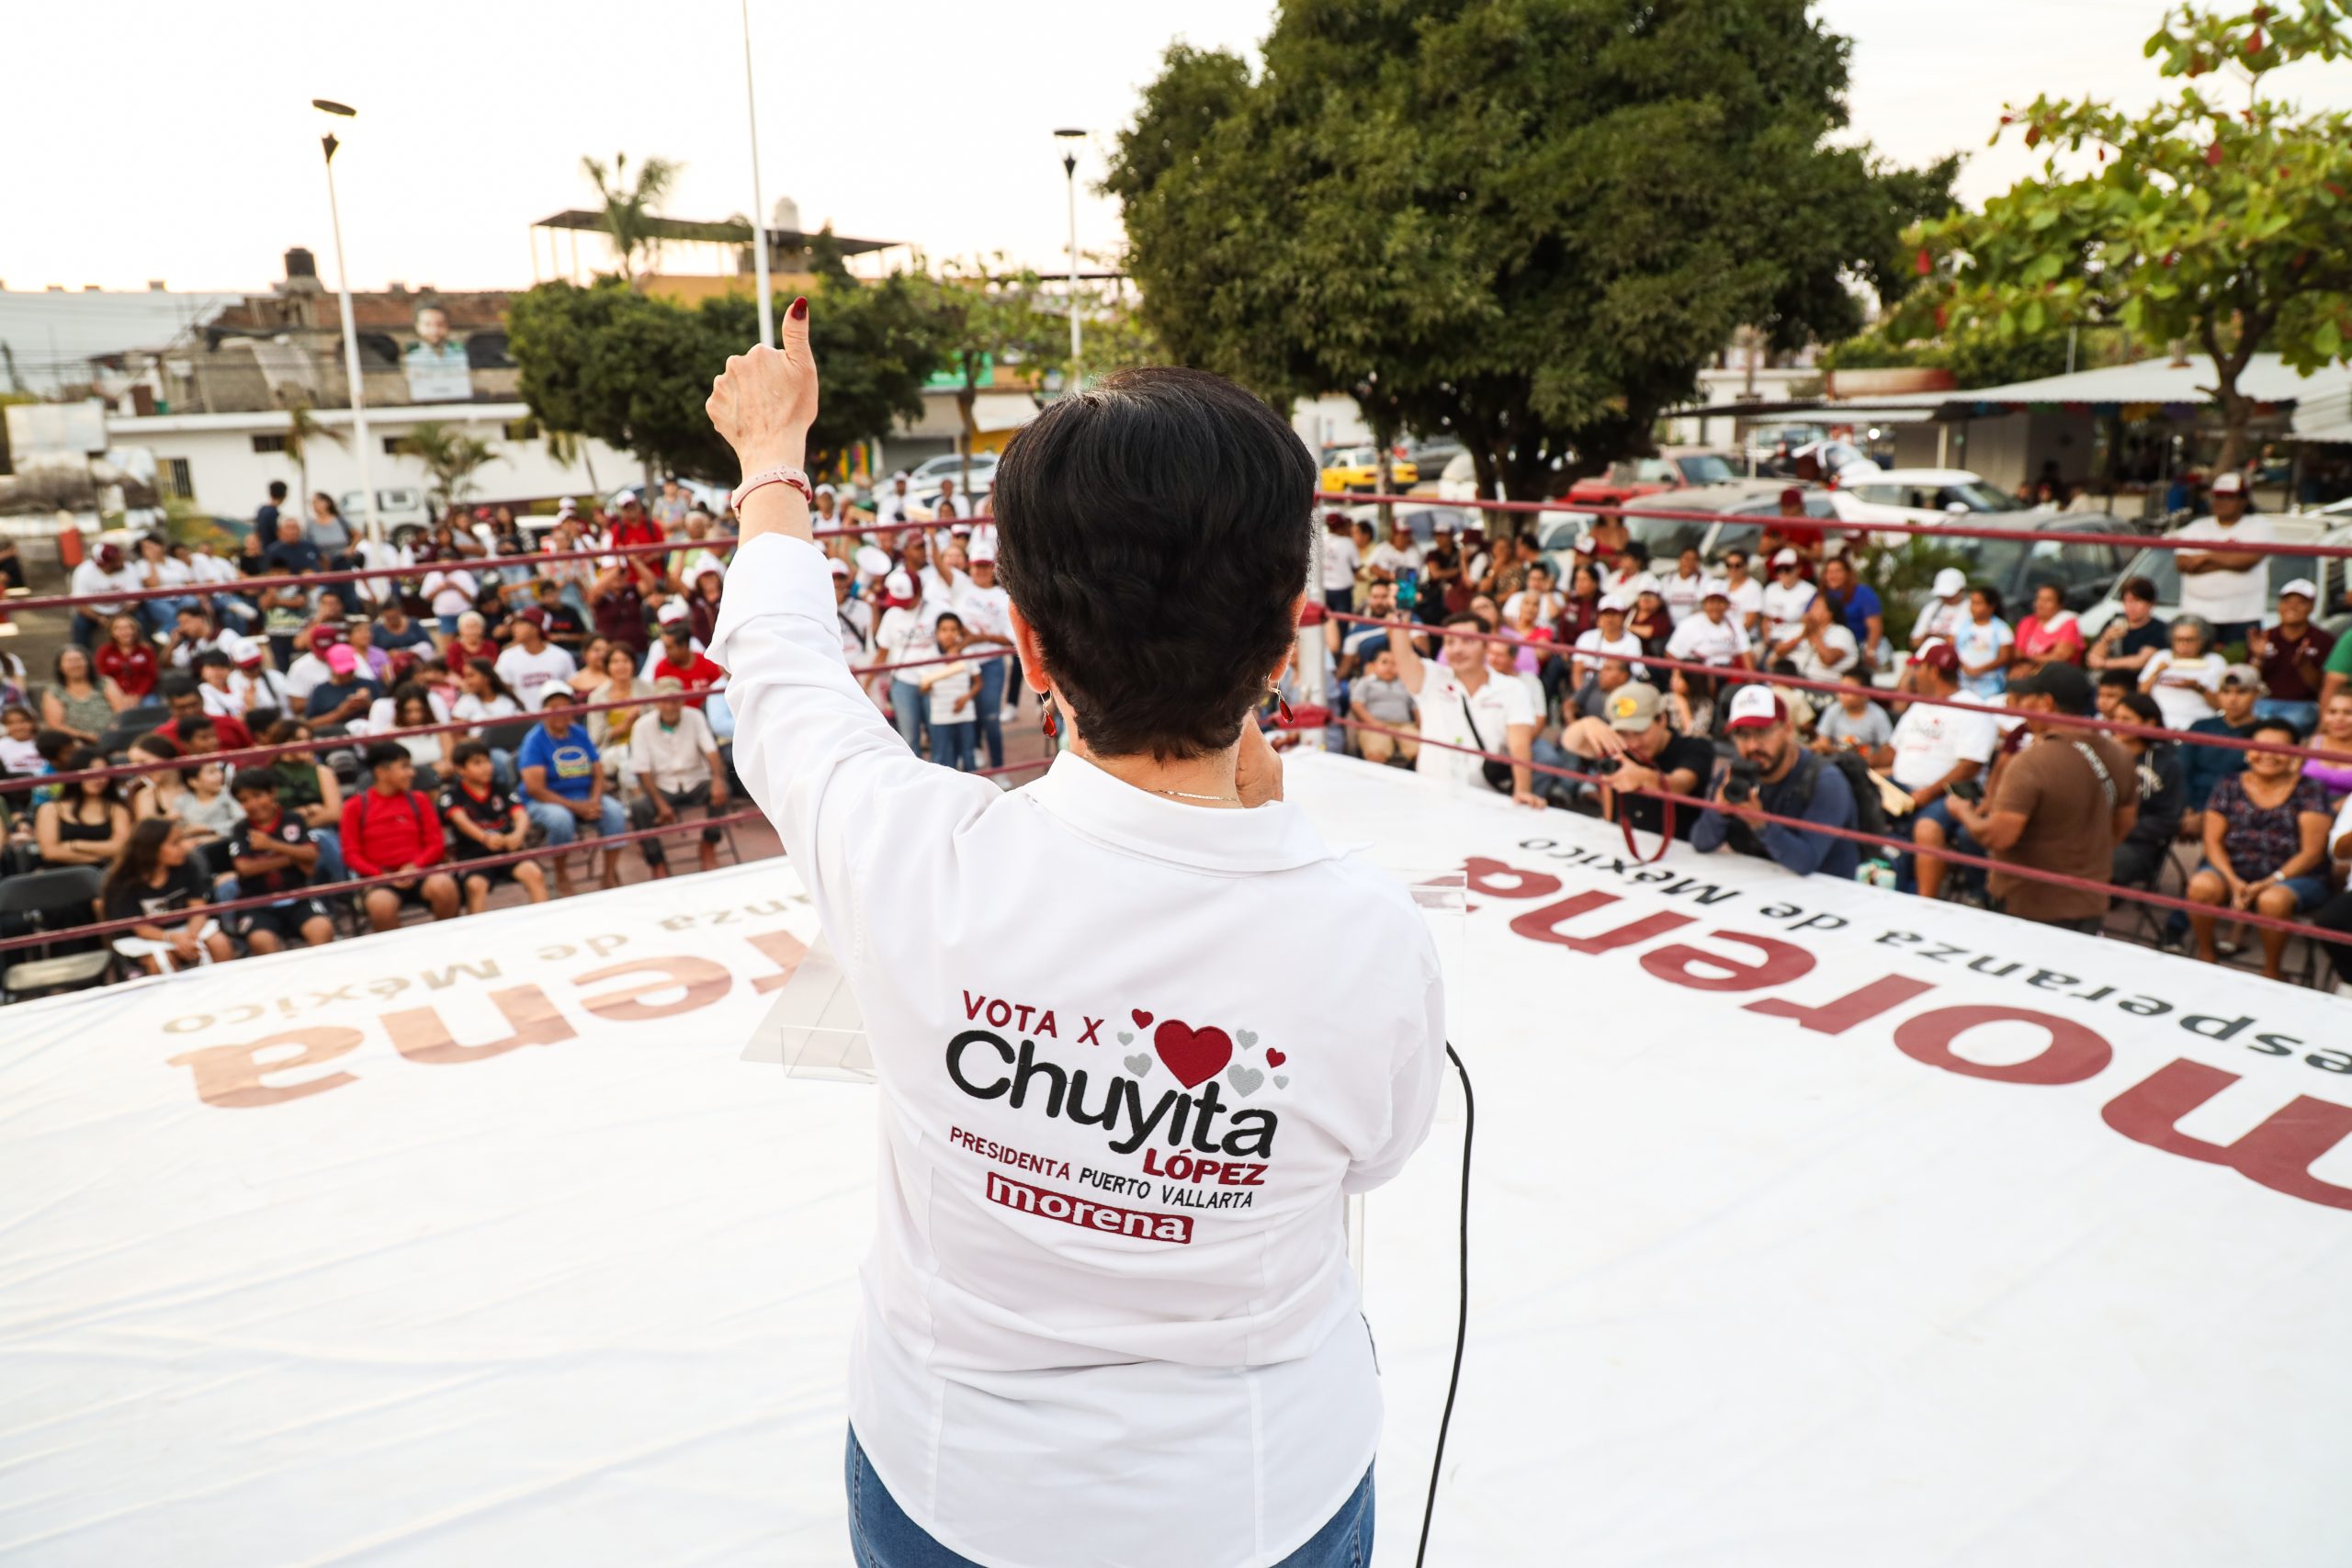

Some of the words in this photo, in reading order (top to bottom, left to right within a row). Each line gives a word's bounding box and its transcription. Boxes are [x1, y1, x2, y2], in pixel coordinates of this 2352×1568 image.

[1519, 838, 1742, 906] México
[539, 934, 628, 962] de
[1758, 901, 1849, 932] de
[162, 959, 503, 1034] México
[165, 929, 814, 1110] rena
[963, 990, 1057, 1039] VOTA
[1078, 1016, 1105, 1046] X
[1875, 930, 2352, 1077] esperanza
[945, 1030, 1278, 1158] Chuyita
[949, 1125, 1070, 1181] PRESIDENTA
[1079, 1168, 1152, 1200] PUERTO
[1162, 1185, 1253, 1210] VALLARTA
[1142, 1148, 1269, 1186] LÓPEZ
[990, 1176, 1187, 1242] morena
